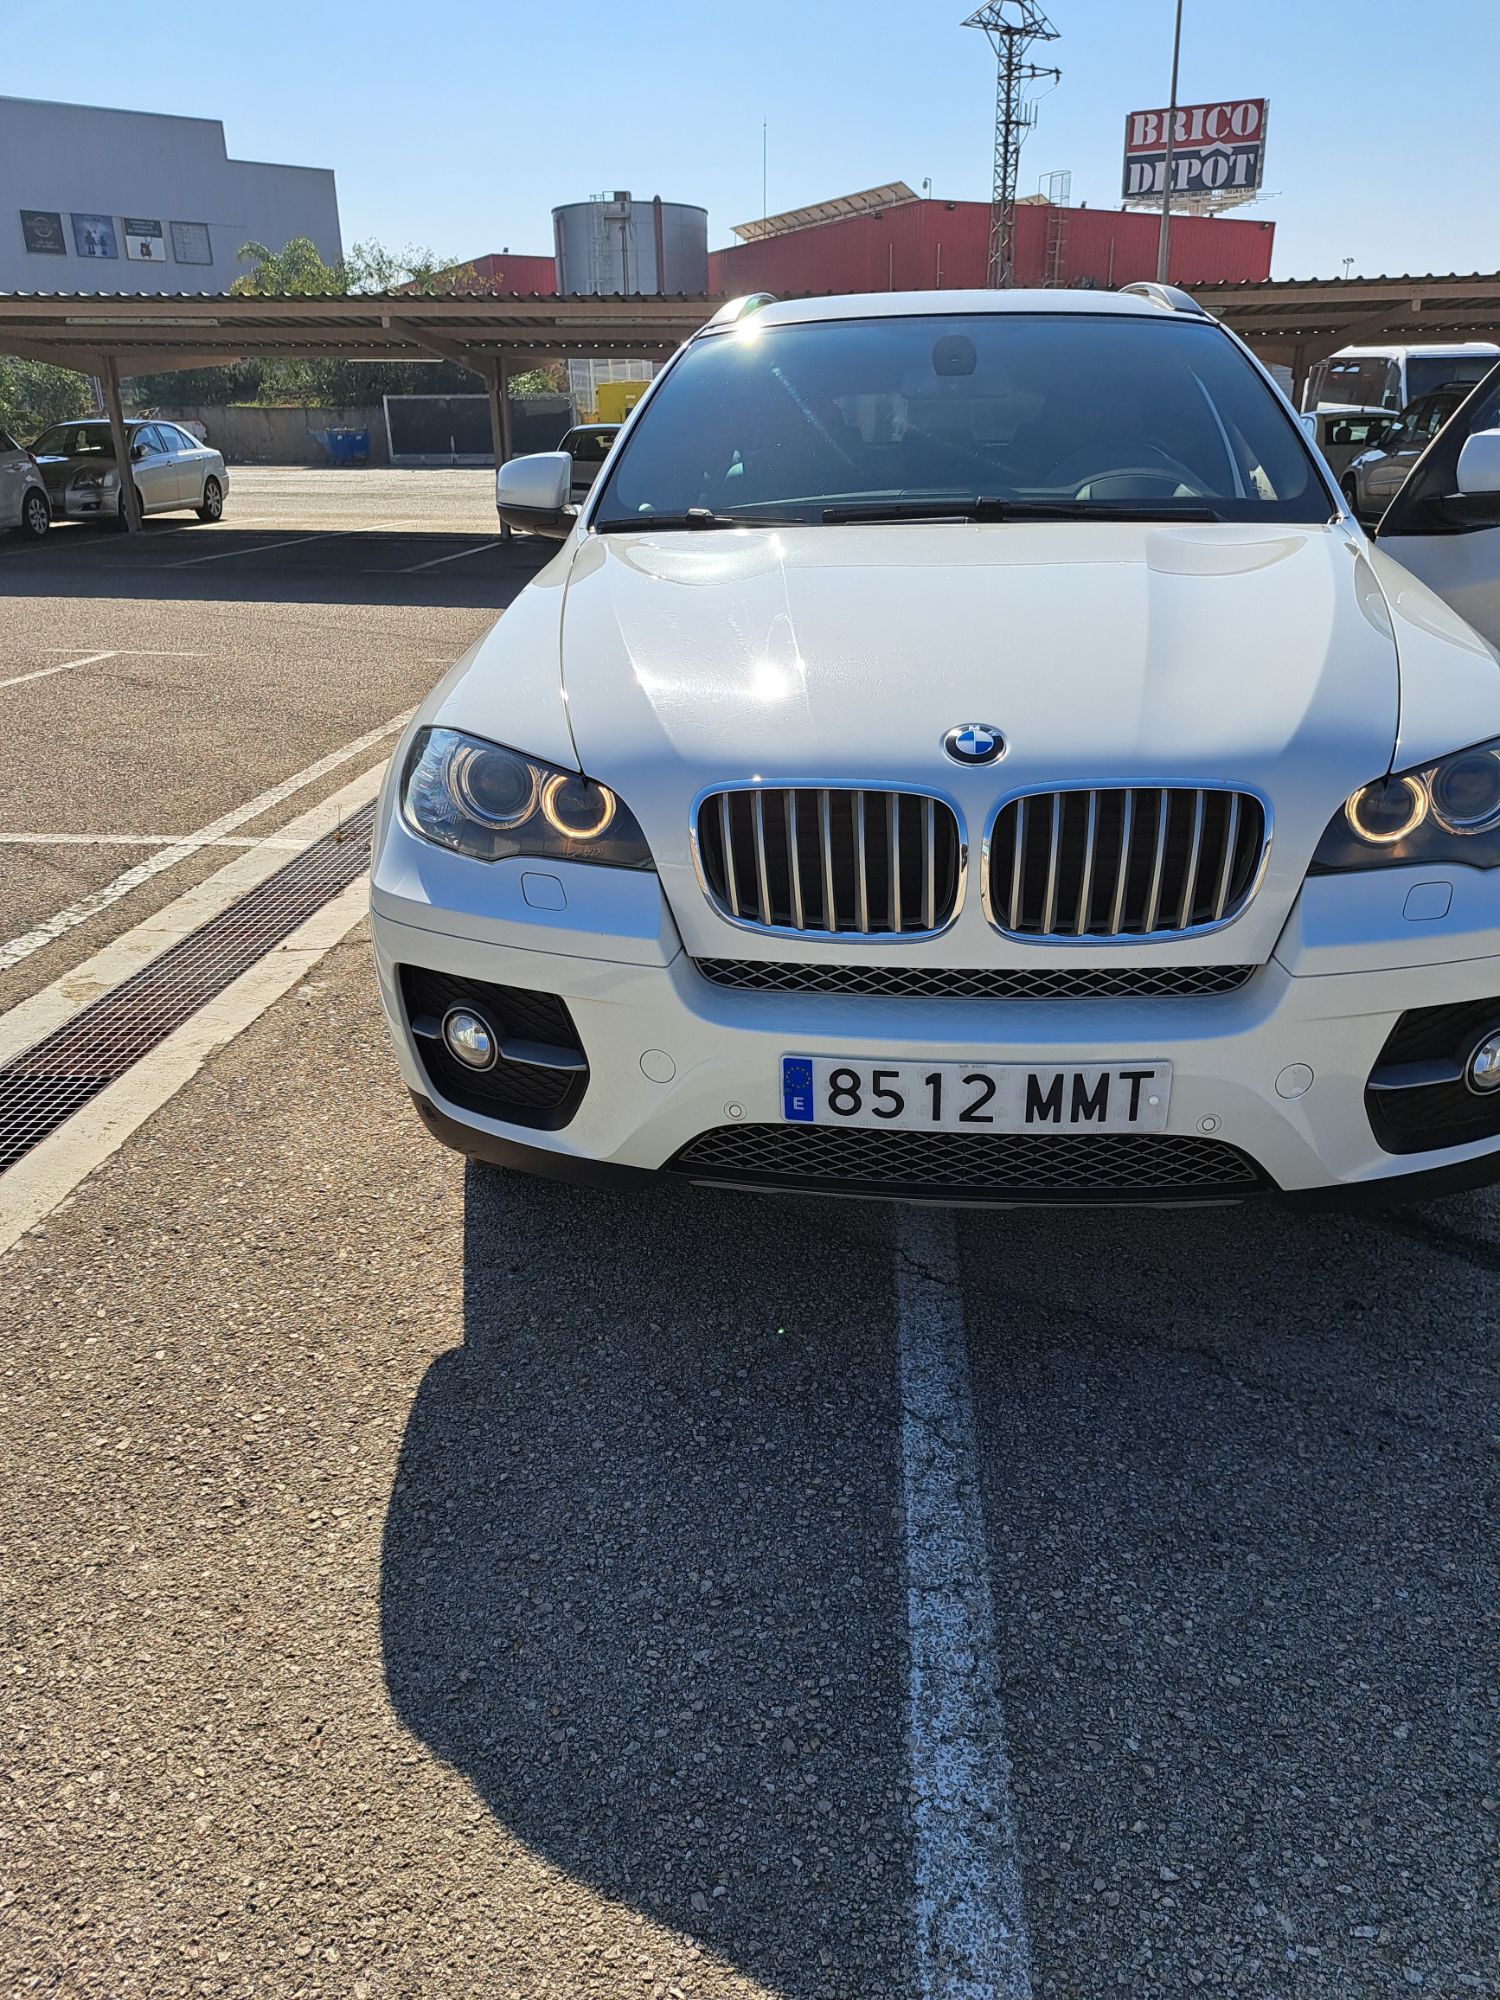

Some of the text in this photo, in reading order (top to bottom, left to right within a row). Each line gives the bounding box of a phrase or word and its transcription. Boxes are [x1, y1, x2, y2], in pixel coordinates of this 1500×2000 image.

[1131, 103, 1259, 146] BRICO
[793, 1096, 805, 1111] E
[828, 1068, 1155, 1124] 8512 MMT
